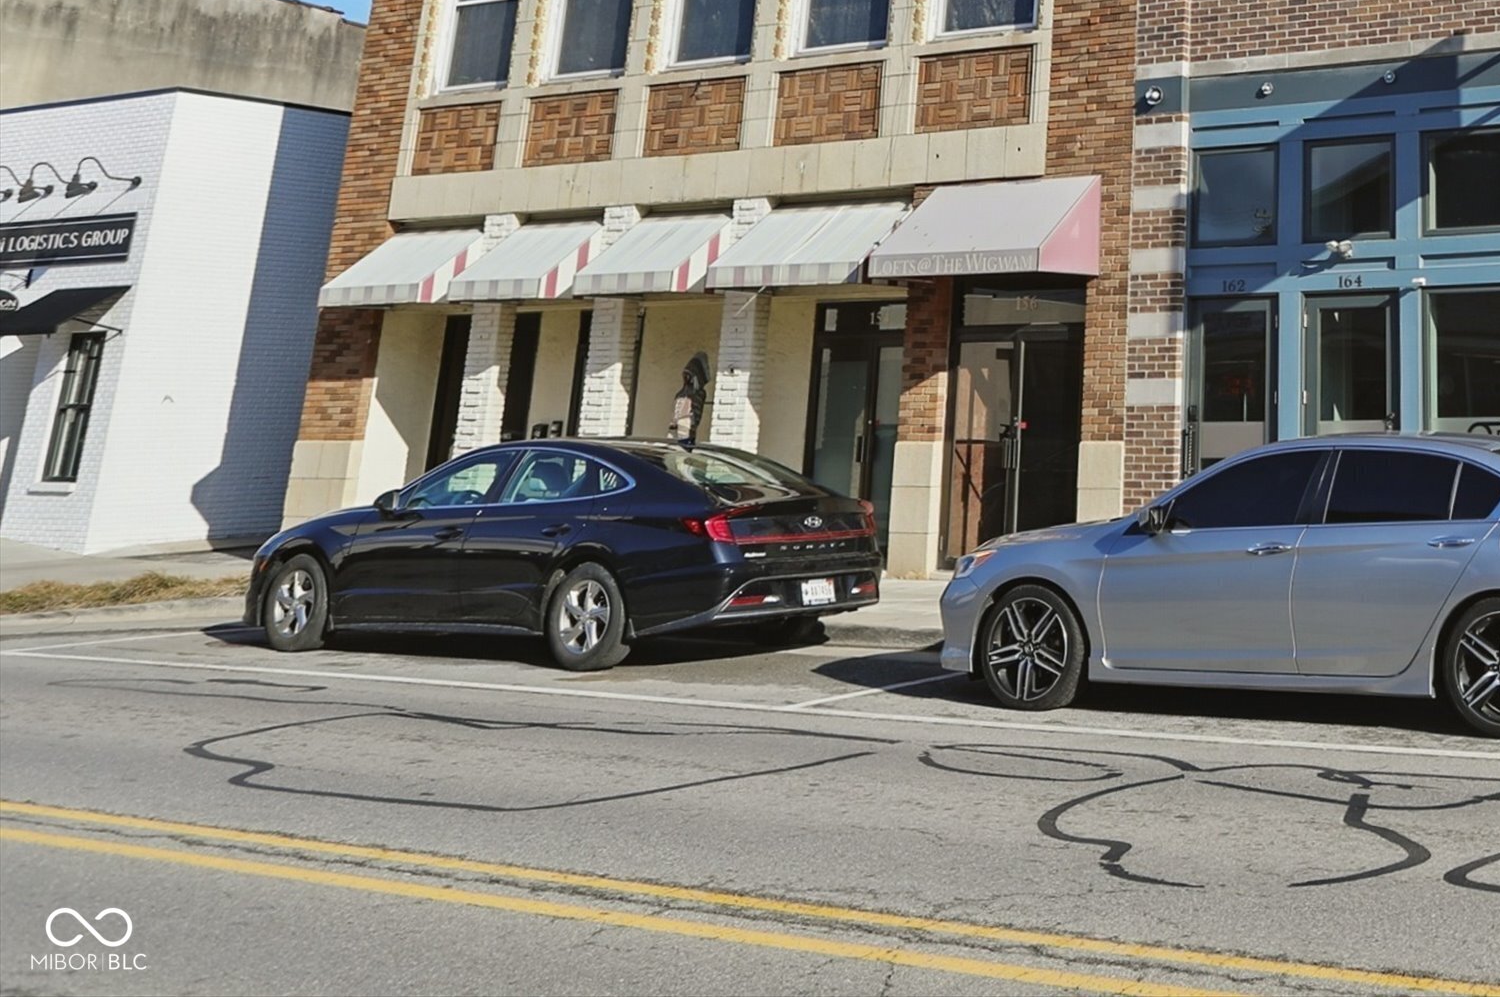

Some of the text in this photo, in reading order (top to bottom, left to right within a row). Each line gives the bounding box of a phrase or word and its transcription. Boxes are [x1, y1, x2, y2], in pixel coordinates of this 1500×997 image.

[7, 232, 79, 253] LOGISTICS
[81, 228, 129, 248] GROUP
[1221, 279, 1245, 293] 162
[1338, 275, 1363, 288] 164
[1015, 296, 1039, 311] 156
